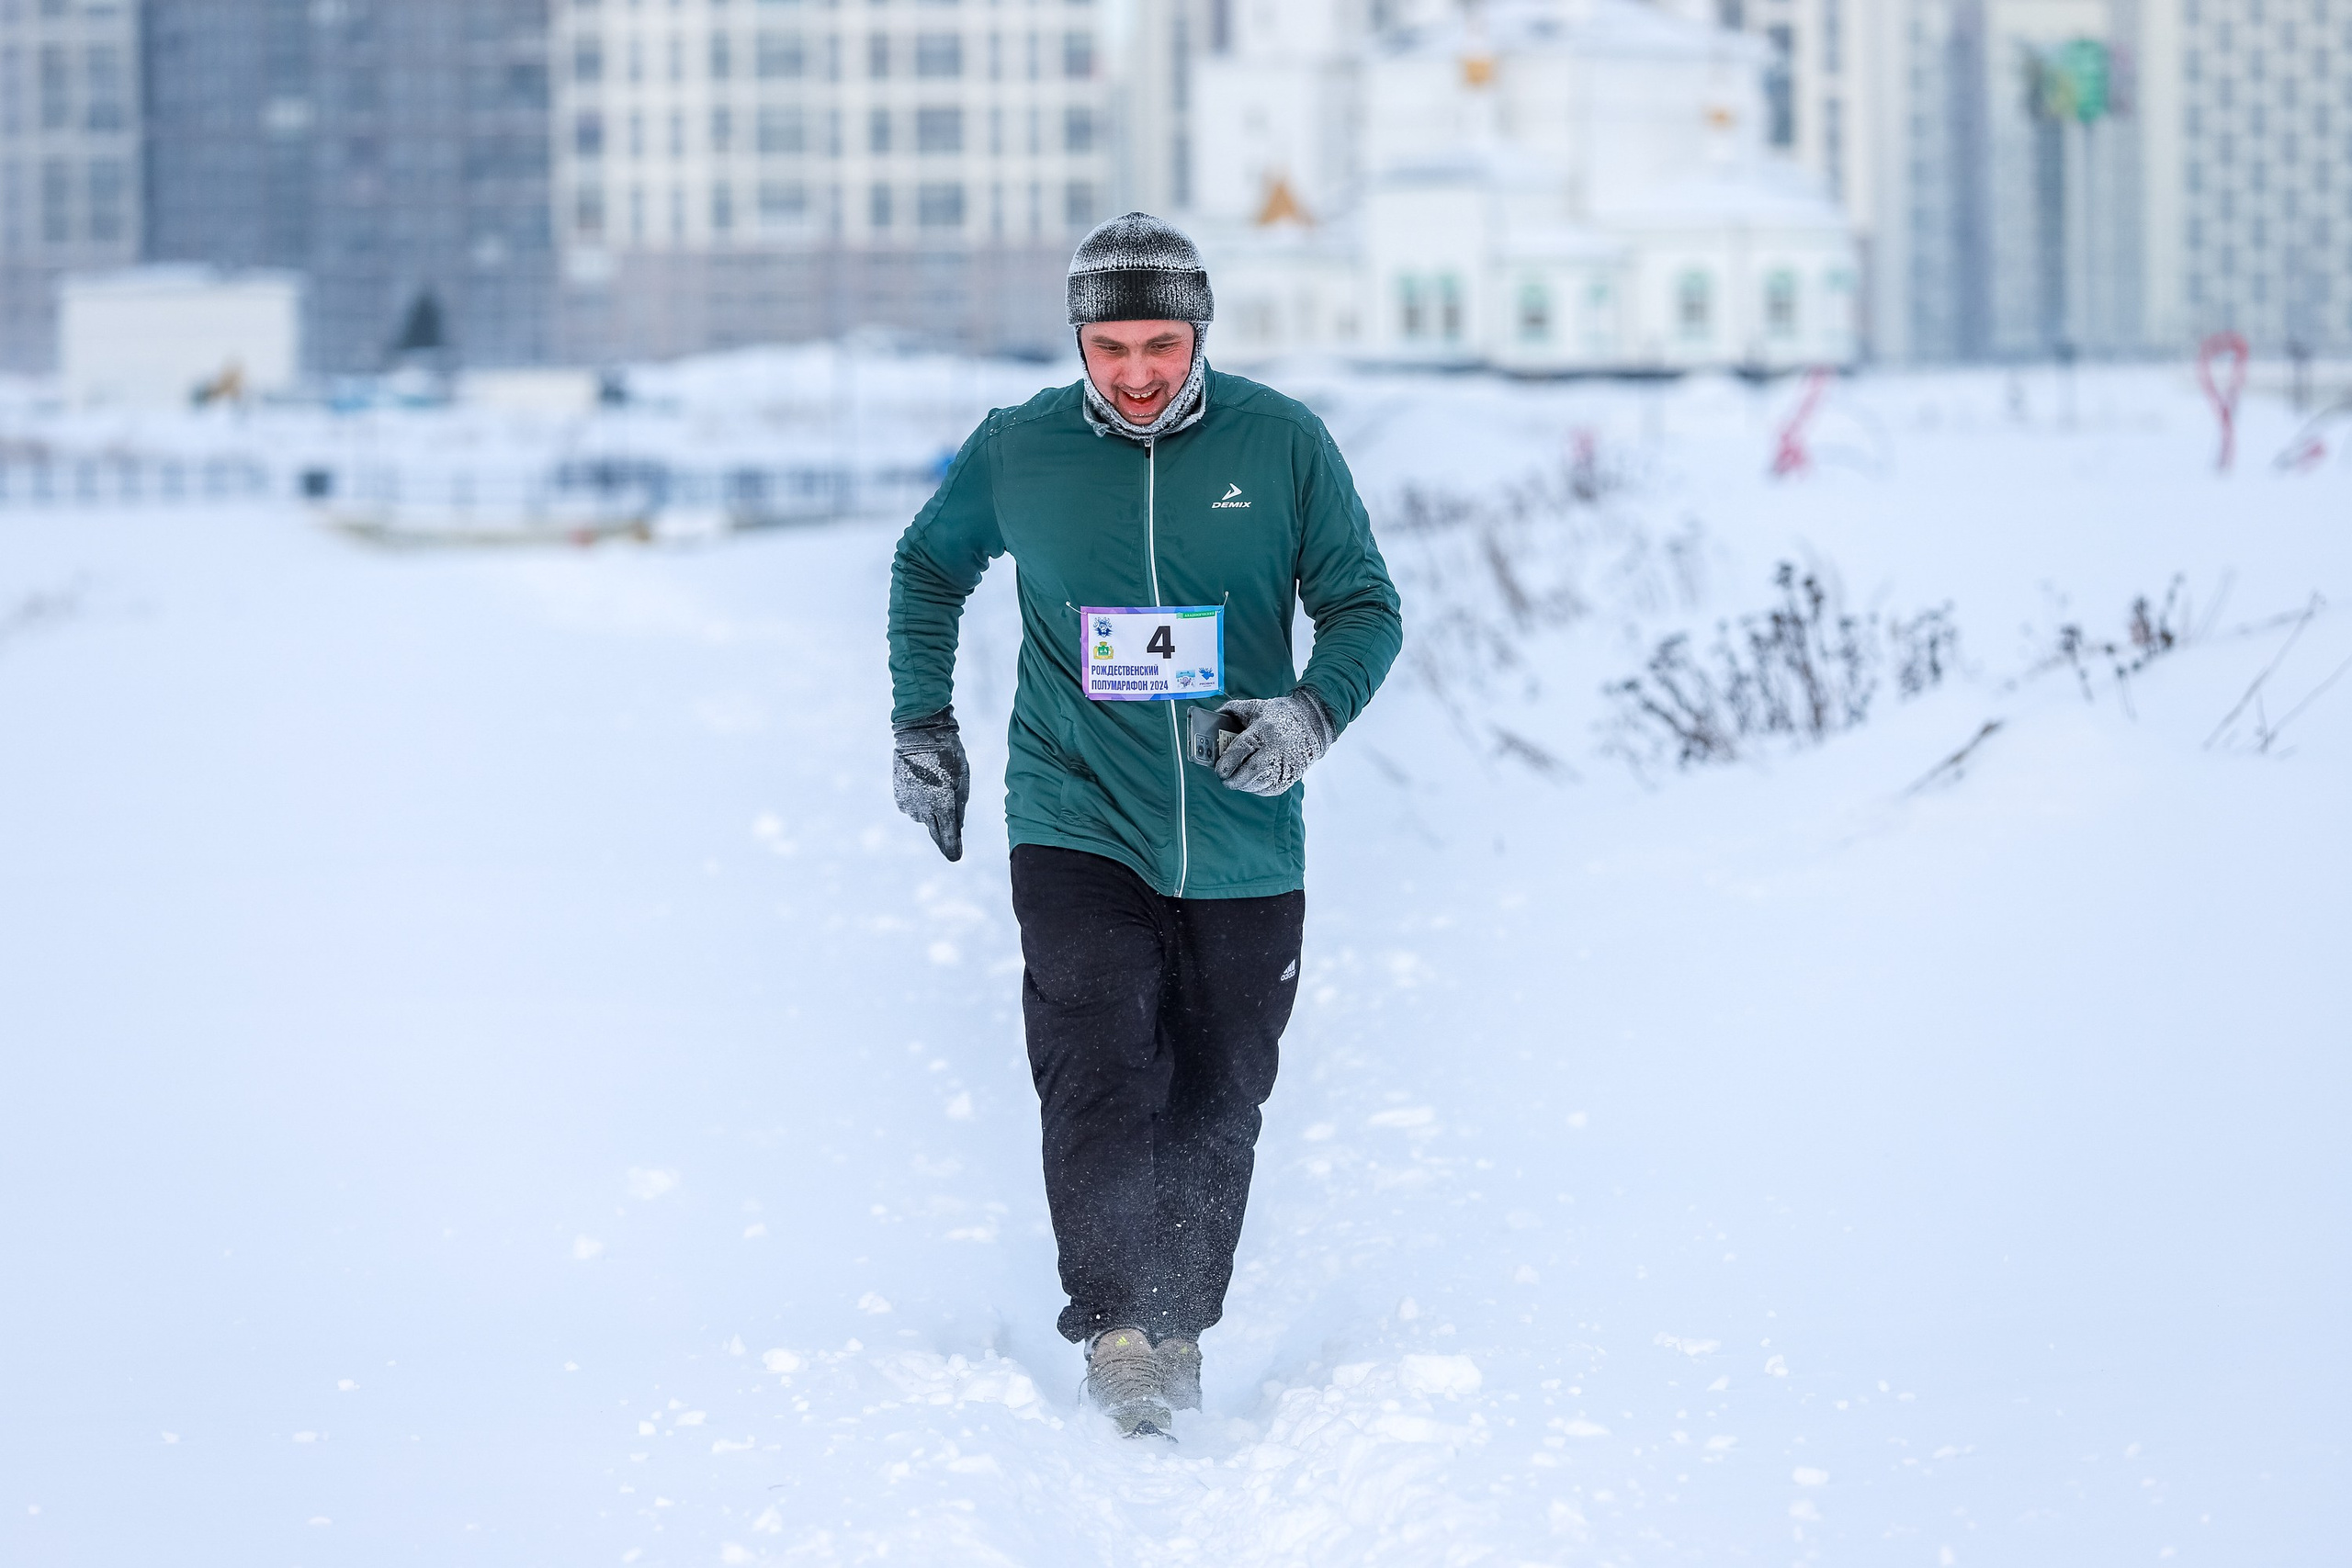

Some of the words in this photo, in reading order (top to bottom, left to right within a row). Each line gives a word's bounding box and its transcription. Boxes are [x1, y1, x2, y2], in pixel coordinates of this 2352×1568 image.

[1147, 626, 1175, 660] 4
[1091, 664, 1159, 676] РОЖДЕСТВЕНСКИЙ
[1091, 680, 1148, 691] ПОЛУМАРАФОН
[1150, 681, 1169, 690] 2024
